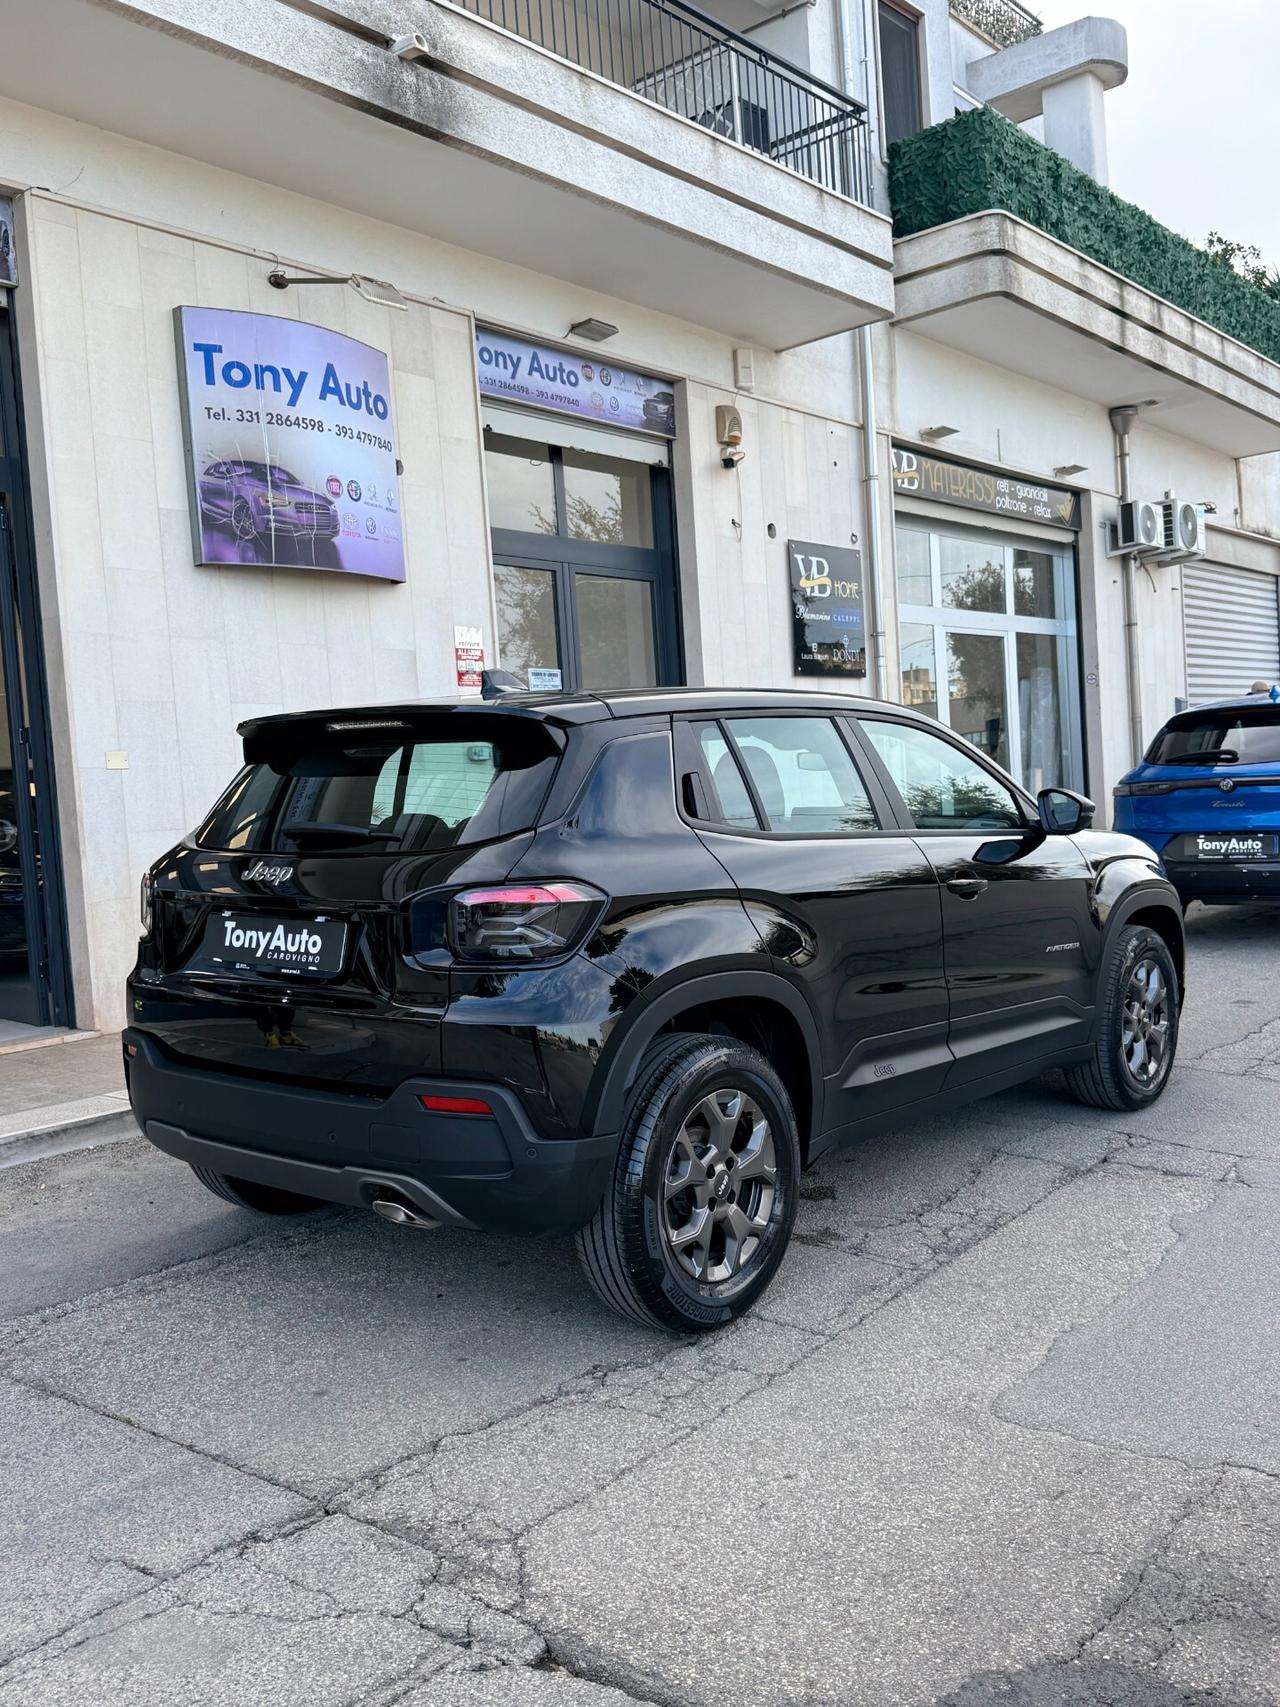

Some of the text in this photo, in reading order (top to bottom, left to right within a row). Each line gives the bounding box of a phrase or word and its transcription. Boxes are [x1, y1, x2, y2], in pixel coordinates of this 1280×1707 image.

[476, 334, 580, 388] ony Auto
[193, 342, 389, 420] Tony Auto
[204, 407, 231, 421] Tel.
[236, 409, 260, 423] 331
[265, 412, 324, 433] 2864598
[335, 424, 354, 440] 393
[356, 430, 392, 452] 4797840
[921, 461, 994, 504] MATERASSI
[996, 479, 1009, 493] reti
[1016, 484, 1048, 502] guanciali
[995, 495, 1027, 513] poltrone
[1033, 505, 1051, 518] relax
[794, 553, 832, 598] VB
[834, 581, 859, 599] HOME
[1196, 838, 1262, 853] TonyAuto
[241, 861, 293, 886] Jeep
[224, 921, 322, 957] TonyAuto
[267, 951, 320, 963] CAROVIGNO
[874, 1064, 896, 1078] Jeep
[718, 1174, 729, 1195] Jeep
